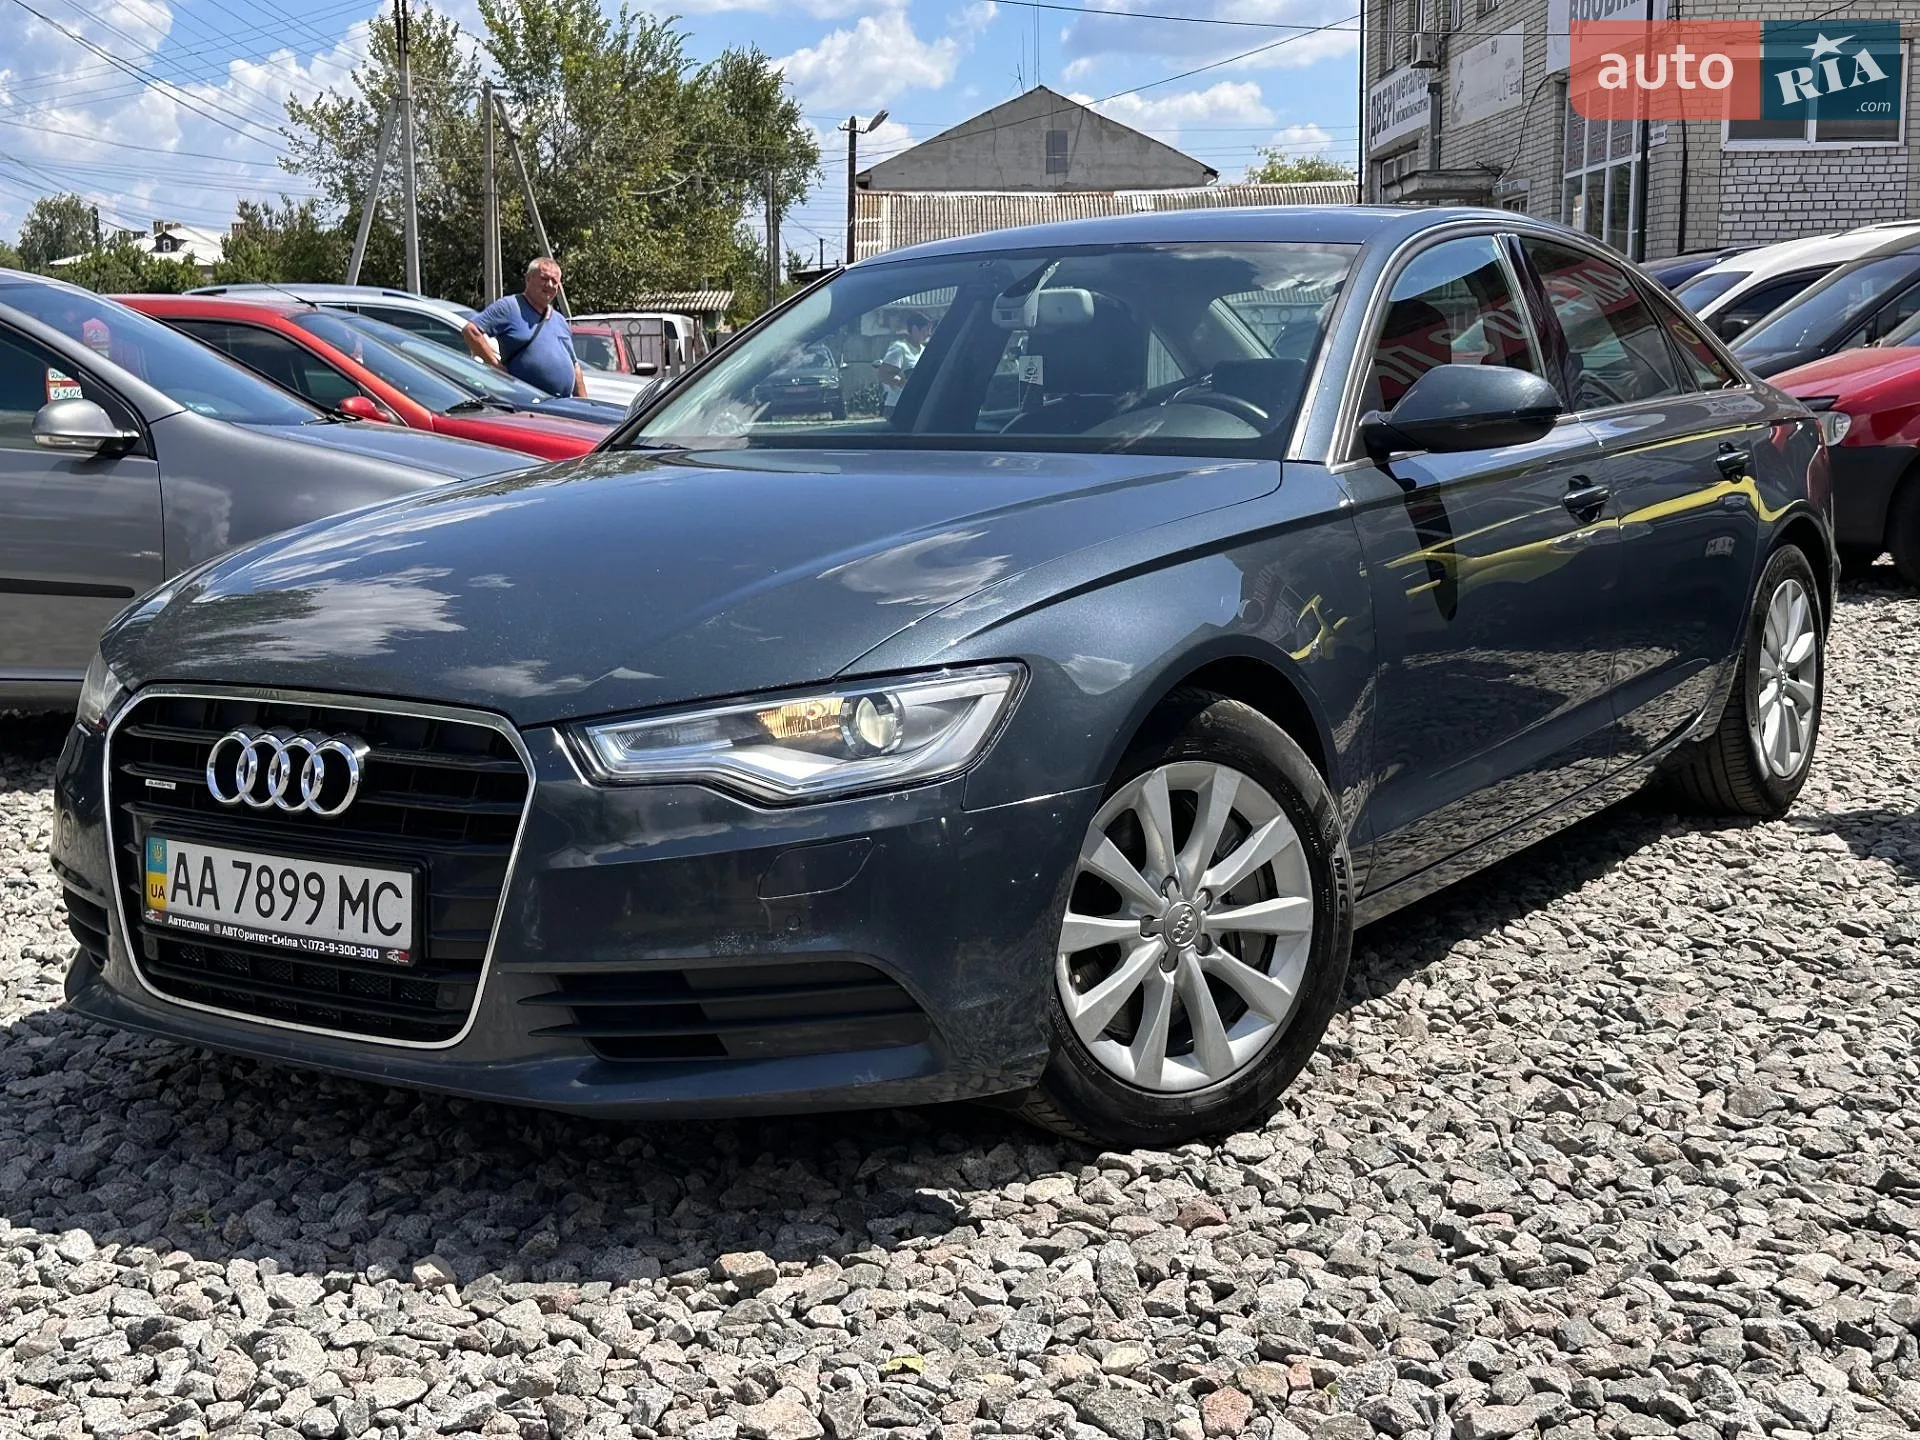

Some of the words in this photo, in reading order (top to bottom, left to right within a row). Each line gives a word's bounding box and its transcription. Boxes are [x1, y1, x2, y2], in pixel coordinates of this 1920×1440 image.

[150, 884, 166, 900] UA
[171, 852, 220, 910] AA
[232, 860, 325, 925] 7899
[338, 875, 403, 936] MC
[168, 915, 210, 932] Автосалон
[308, 939, 379, 959] 073-9-300-300
